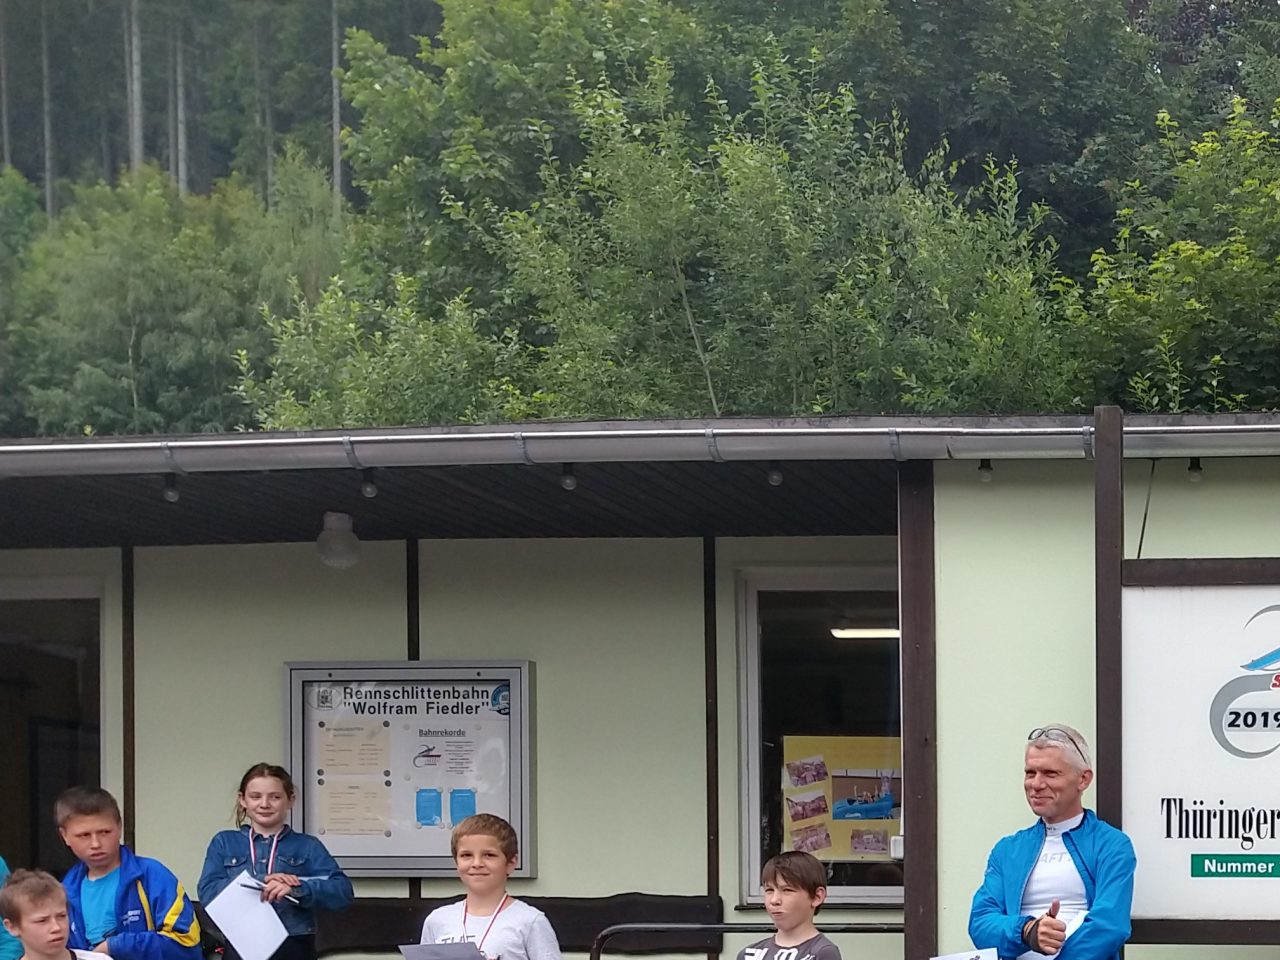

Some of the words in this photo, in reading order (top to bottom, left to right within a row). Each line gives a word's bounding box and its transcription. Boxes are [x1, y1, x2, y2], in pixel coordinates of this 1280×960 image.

[343, 686, 490, 701] Rennschlittenbahn
[418, 728, 466, 737] Bahnrekorde
[1161, 797, 1280, 851] Thüringer
[1204, 859, 1276, 875] Nummer
